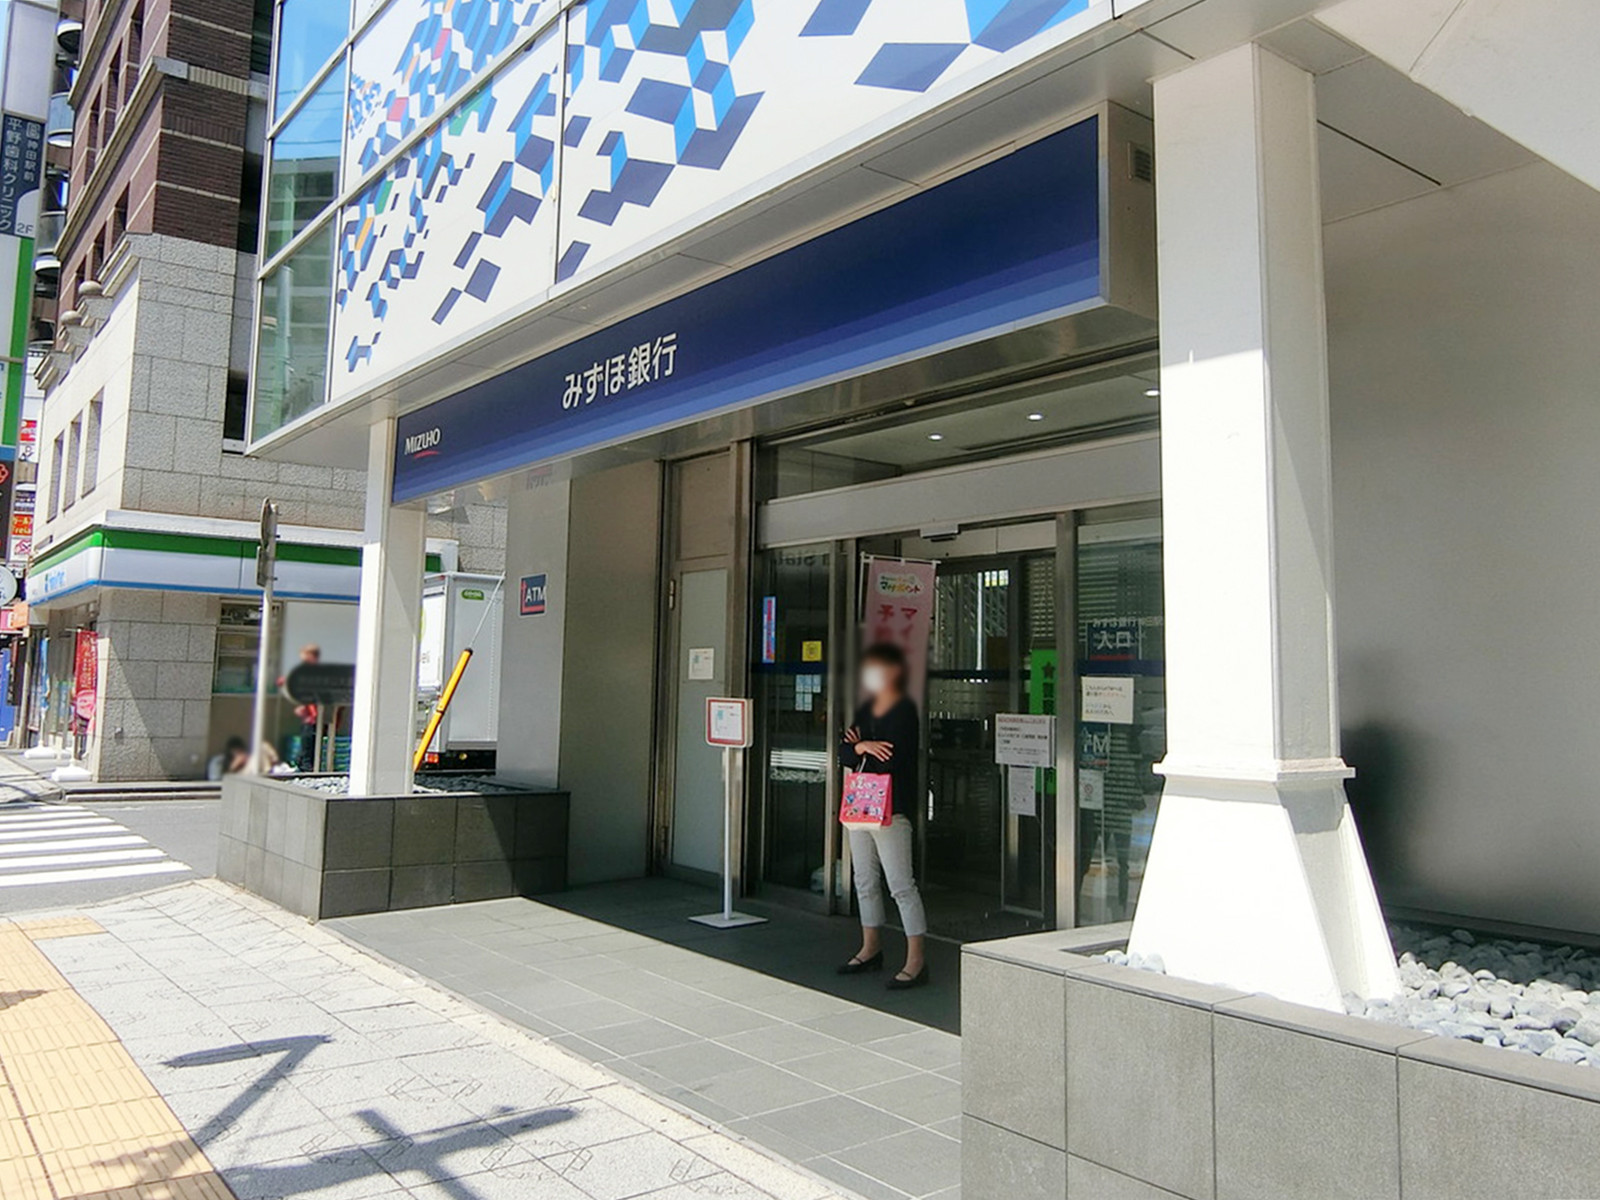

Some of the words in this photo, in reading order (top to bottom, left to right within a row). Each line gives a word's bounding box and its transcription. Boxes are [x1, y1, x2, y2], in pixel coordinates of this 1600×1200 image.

[0, 117, 22, 231] 平野歯科クリニック
[17, 222, 34, 234] 2F
[562, 333, 677, 409] みずほ銀行
[404, 427, 441, 455] MIZUHO
[525, 585, 547, 603] ATM
[1097, 630, 1131, 650] 入口
